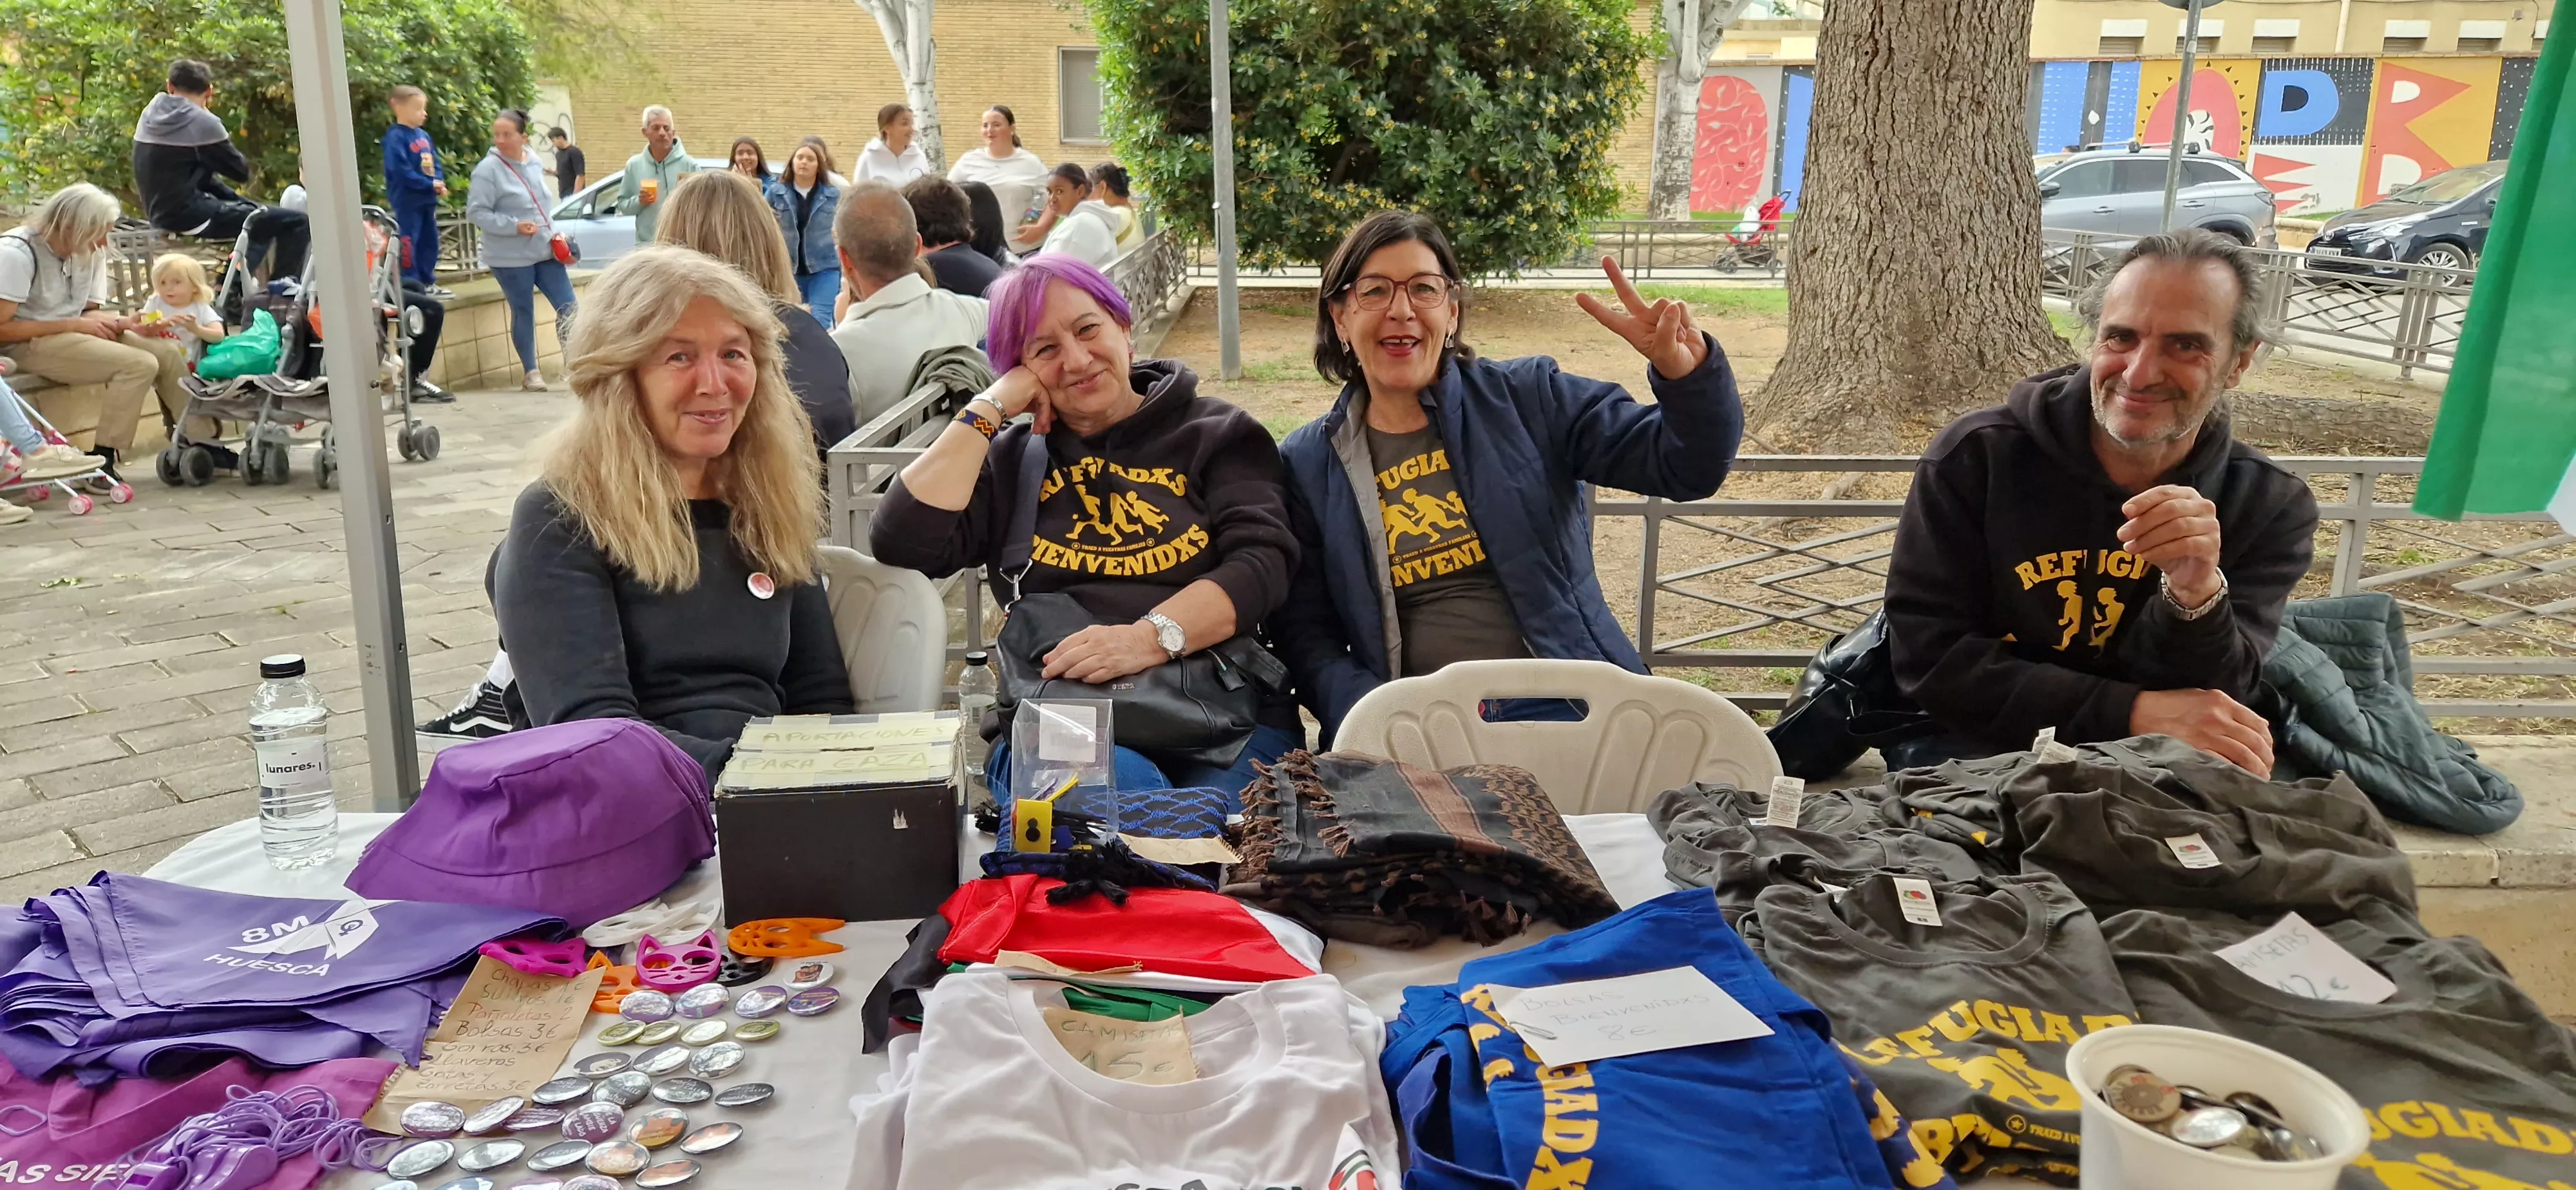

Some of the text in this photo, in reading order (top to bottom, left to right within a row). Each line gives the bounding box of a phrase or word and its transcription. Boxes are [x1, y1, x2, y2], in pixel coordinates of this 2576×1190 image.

[762, 725, 945, 743] APORTACIONES
[741, 751, 929, 771] PARA GAZA
[242, 915, 310, 943] 8M
[203, 954, 330, 976] HUESCA
[2362, 1100, 2576, 1155] GIAD
[0, 1160, 131, 1184] AS SIE
